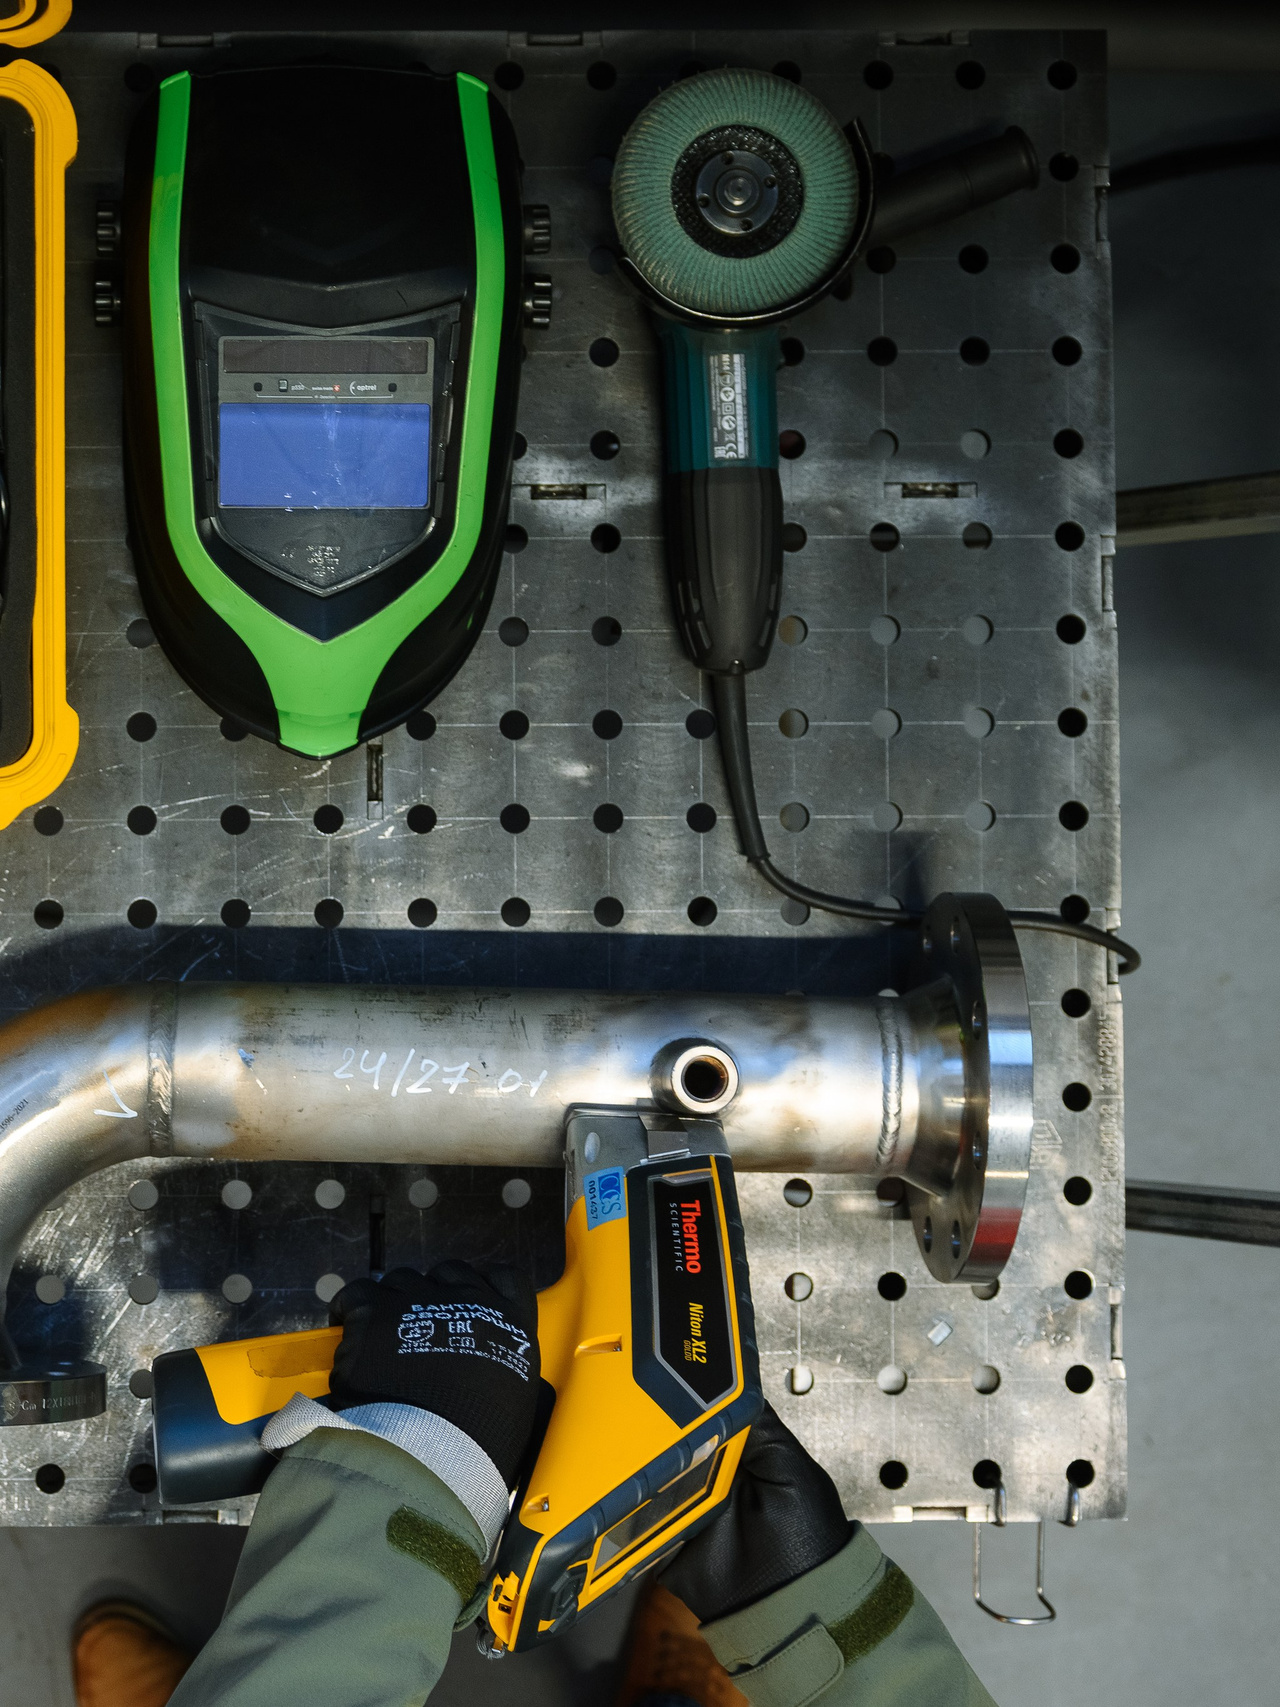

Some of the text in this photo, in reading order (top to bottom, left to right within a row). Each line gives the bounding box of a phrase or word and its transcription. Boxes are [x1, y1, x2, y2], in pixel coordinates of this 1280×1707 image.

[356, 384, 377, 392] optrel
[721, 353, 730, 371] M14
[332, 1046, 471, 1098] 24/27
[599, 1173, 622, 1215] CCS
[669, 1202, 684, 1272] SCIENTIFIC
[680, 1200, 702, 1274] Thermo
[688, 1301, 707, 1364] Niton XL2
